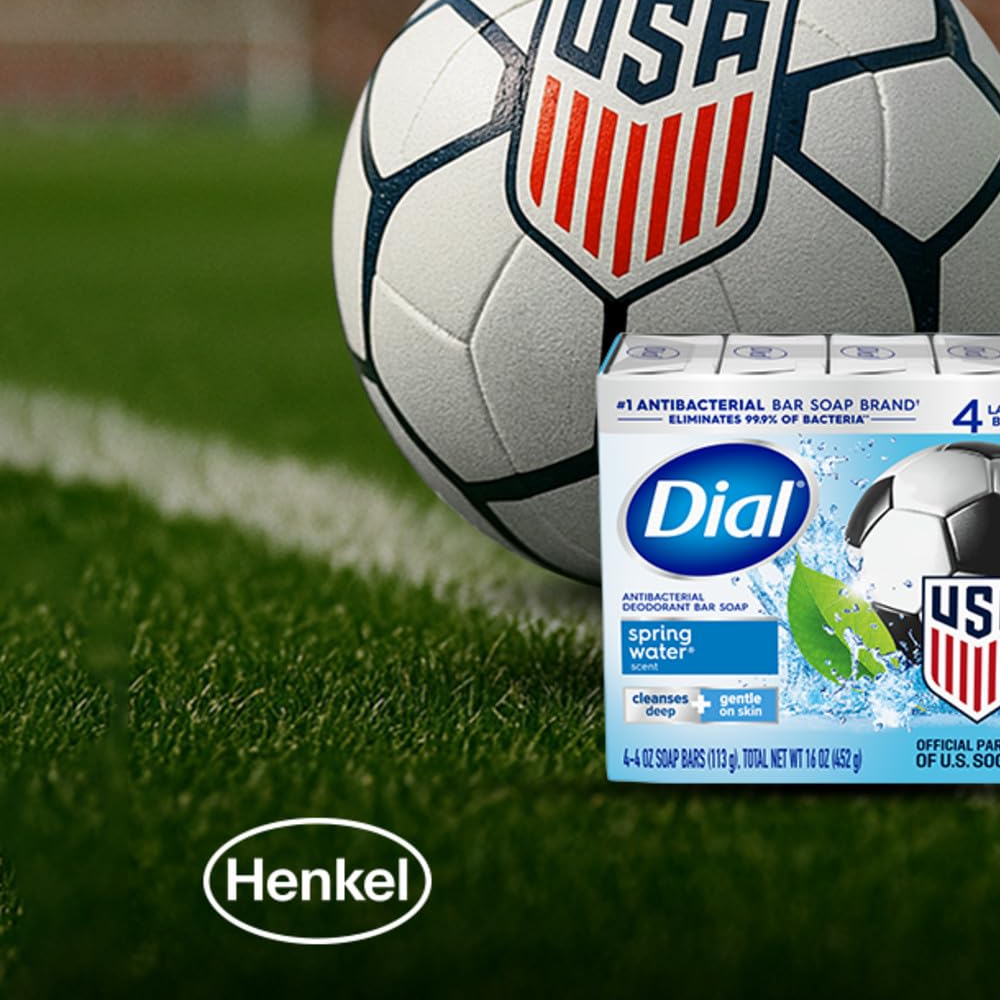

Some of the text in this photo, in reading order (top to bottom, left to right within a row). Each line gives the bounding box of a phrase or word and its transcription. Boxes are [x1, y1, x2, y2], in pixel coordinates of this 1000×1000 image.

[616, 399, 633, 411] #1
[637, 398, 765, 411] ANTIBACTERIAL
[772, 399, 804, 411] BAR
[810, 398, 854, 411] SOAP
[668, 414, 741, 424] ELIMINATES
[745, 414, 778, 424] 99.9%
[781, 414, 799, 424] OF
[952, 398, 983, 434] 4
[643, 479, 796, 539] Dial
[622, 592, 704, 601] ANTIBACTERIAL
[622, 603, 749, 612] DEODORANT BAR SOAP
[628, 624, 692, 646] spring
[631, 662, 659, 671] scent
[632, 692, 762, 706] cleanses gentle
[645, 705, 763, 719] deep on skin
[916, 738, 973, 751] OFFICIAL
[642, 748, 654, 768] OZ
[655, 748, 680, 769] SOAP
[681, 748, 706, 769] BARS
[707, 748, 728, 770] (113
[743, 748, 768, 769] TOTAL
[770, 748, 787, 769] NET
[789, 748, 803, 769] WT
[805, 748, 816, 769] 16
[818, 748, 830, 769] OZ
[831, 748, 852, 770] (452
[916, 753, 936, 768] OF
[940, 753, 970, 768] U.S.
